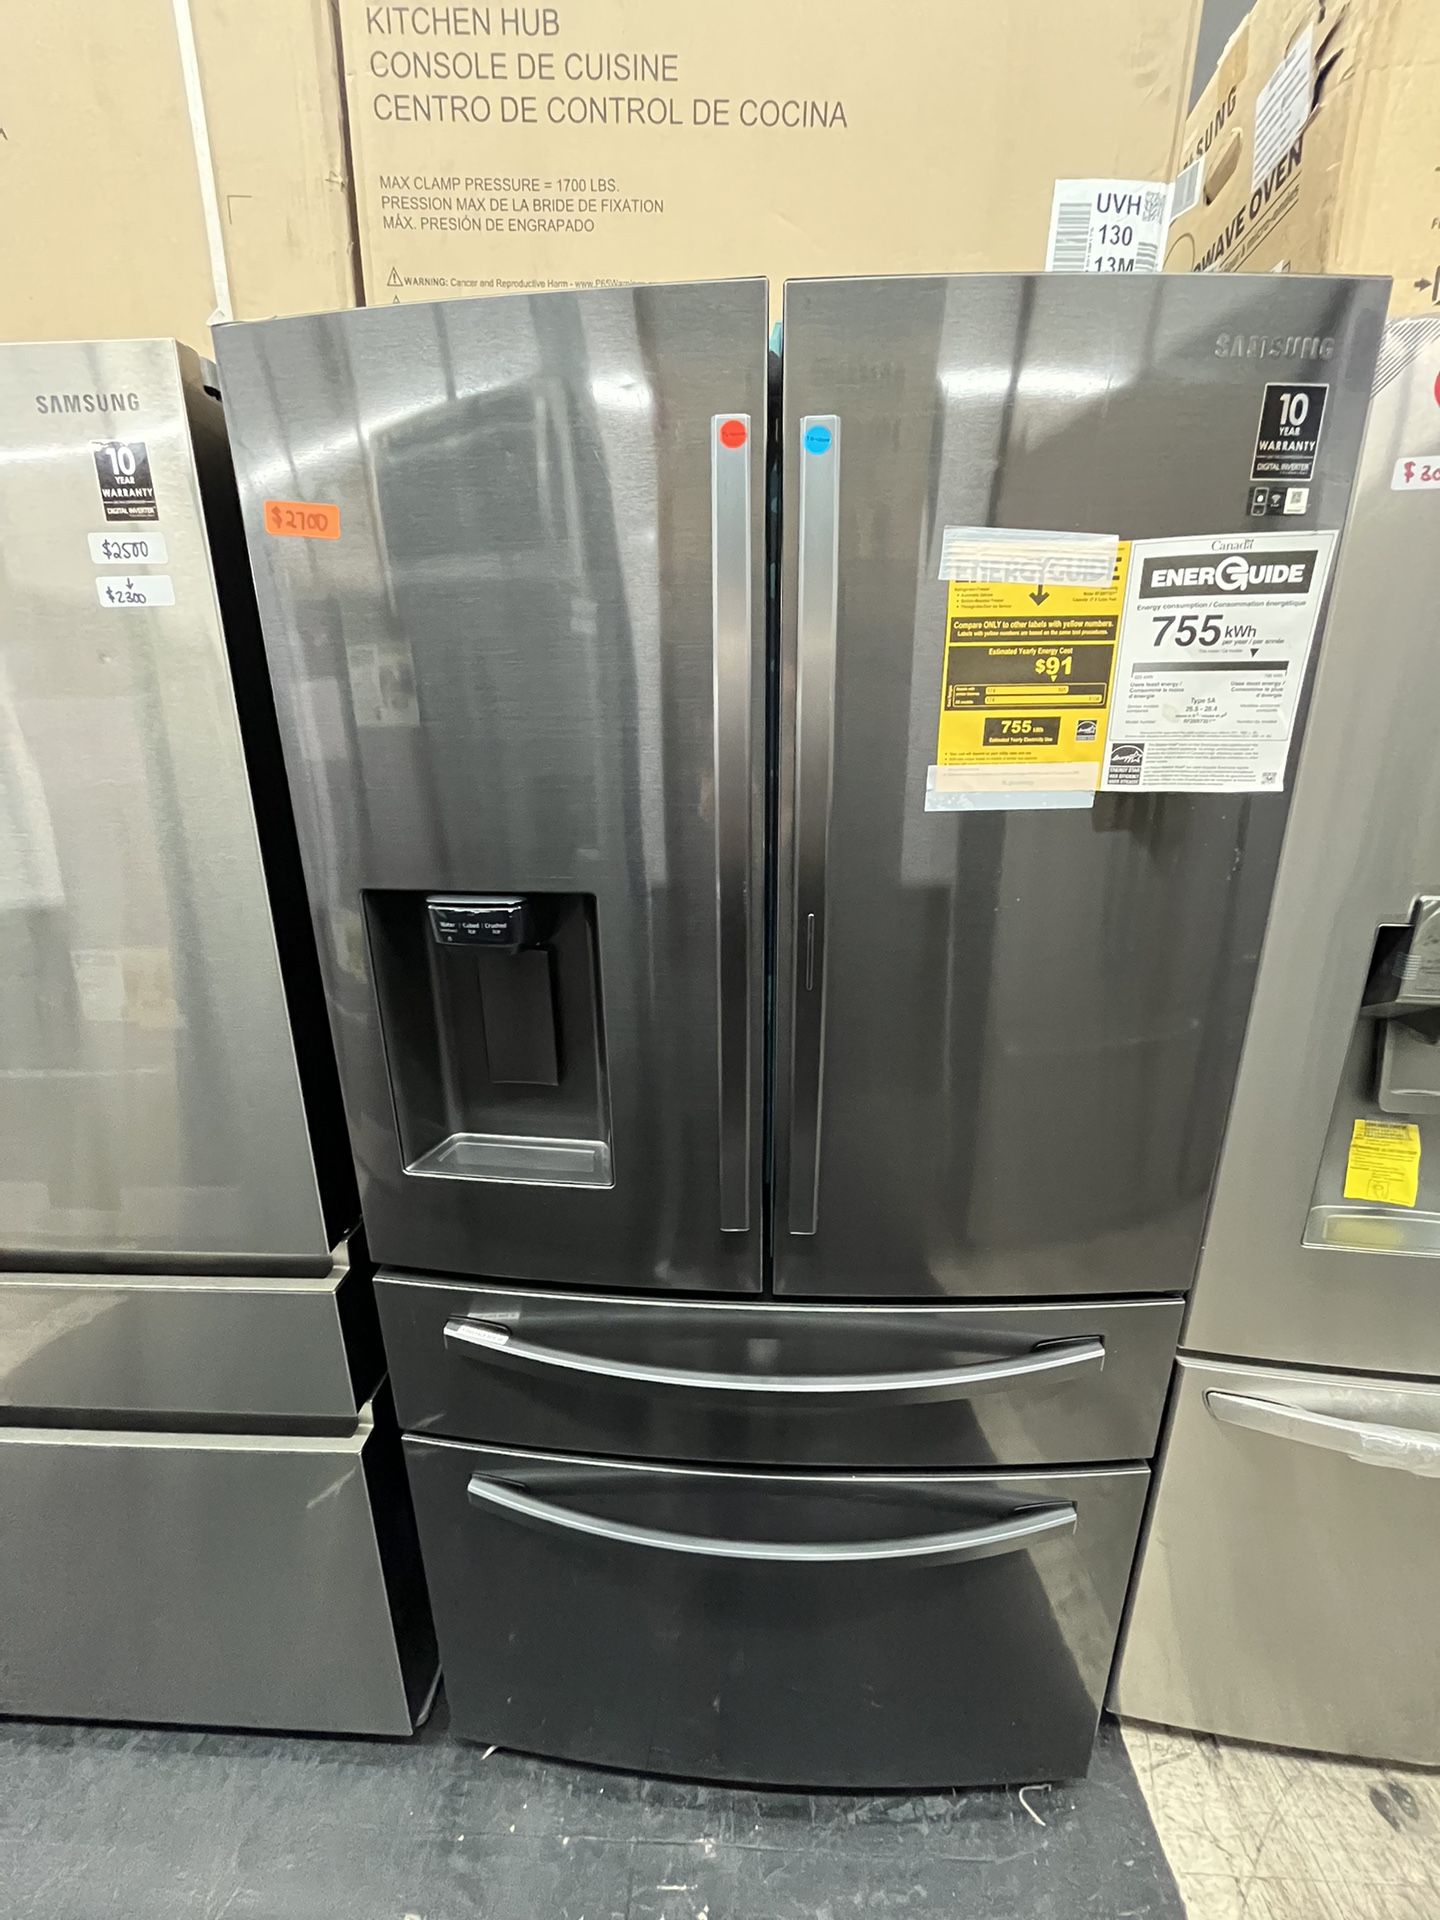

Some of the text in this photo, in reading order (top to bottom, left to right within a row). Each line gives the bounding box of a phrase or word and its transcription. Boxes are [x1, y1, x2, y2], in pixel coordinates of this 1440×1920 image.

[366, 7, 560, 36] KITCHEN HUB
[370, 51, 678, 82] CONSOLE DE CUISINE
[373, 93, 848, 128] CENTRO DE CONTROL DE COCINA
[379, 176, 411, 191] MAX
[413, 177, 461, 191] CLAMP
[465, 178, 540, 192] PRESSURE
[556, 179, 587, 192] 1700
[590, 179, 620, 193] LBS.
[381, 196, 664, 213] PRESSION MAX DE LA BRIDE DE FIXATION
[1096, 193, 1142, 216] UVH
[382, 213, 595, 232] MÁX. PRESIÓN DE ENGRAPADO
[1098, 224, 1134, 247] 130
[404, 277, 449, 287] WARNING:
[450, 279, 478, 287] Cancer
[480, 279, 494, 287] and
[496, 279, 545, 289] Reproductive
[547, 280, 569, 288] Harm
[1213, 333, 1336, 361] SAMSUNG
[35, 392, 140, 415] SAMSUNG
[1279, 392, 1310, 427] 10
[1279, 426, 1301, 437] YEAR
[1259, 440, 1316, 452] WARRANTY
[105, 446, 136, 476] 10
[1256, 462, 1280, 472] DIGITAL
[115, 476, 135, 485] YEAR
[102, 488, 153, 498] WARRANTY
[271, 506, 330, 532] $2700
[102, 539, 149, 560] $2500
[1211, 540, 1254, 552] Canada
[1151, 556, 1306, 591] ENERGUIDE
[106, 586, 147, 605] $2300
[1137, 603, 1161, 612] Energy
[1163, 602, 1208, 610] consumption
[1213, 600, 1264, 608] Consommation
[953, 619, 1114, 630] Compare ONLY to other labels with yellow numbers.
[1152, 614, 1257, 647] 755 kWh
[988, 646, 1073, 656] Estimated Yearly Energy Cost
[1035, 656, 1073, 676] $91
[1191, 697, 1206, 705] Type
[1001, 720, 1032, 734] 755
